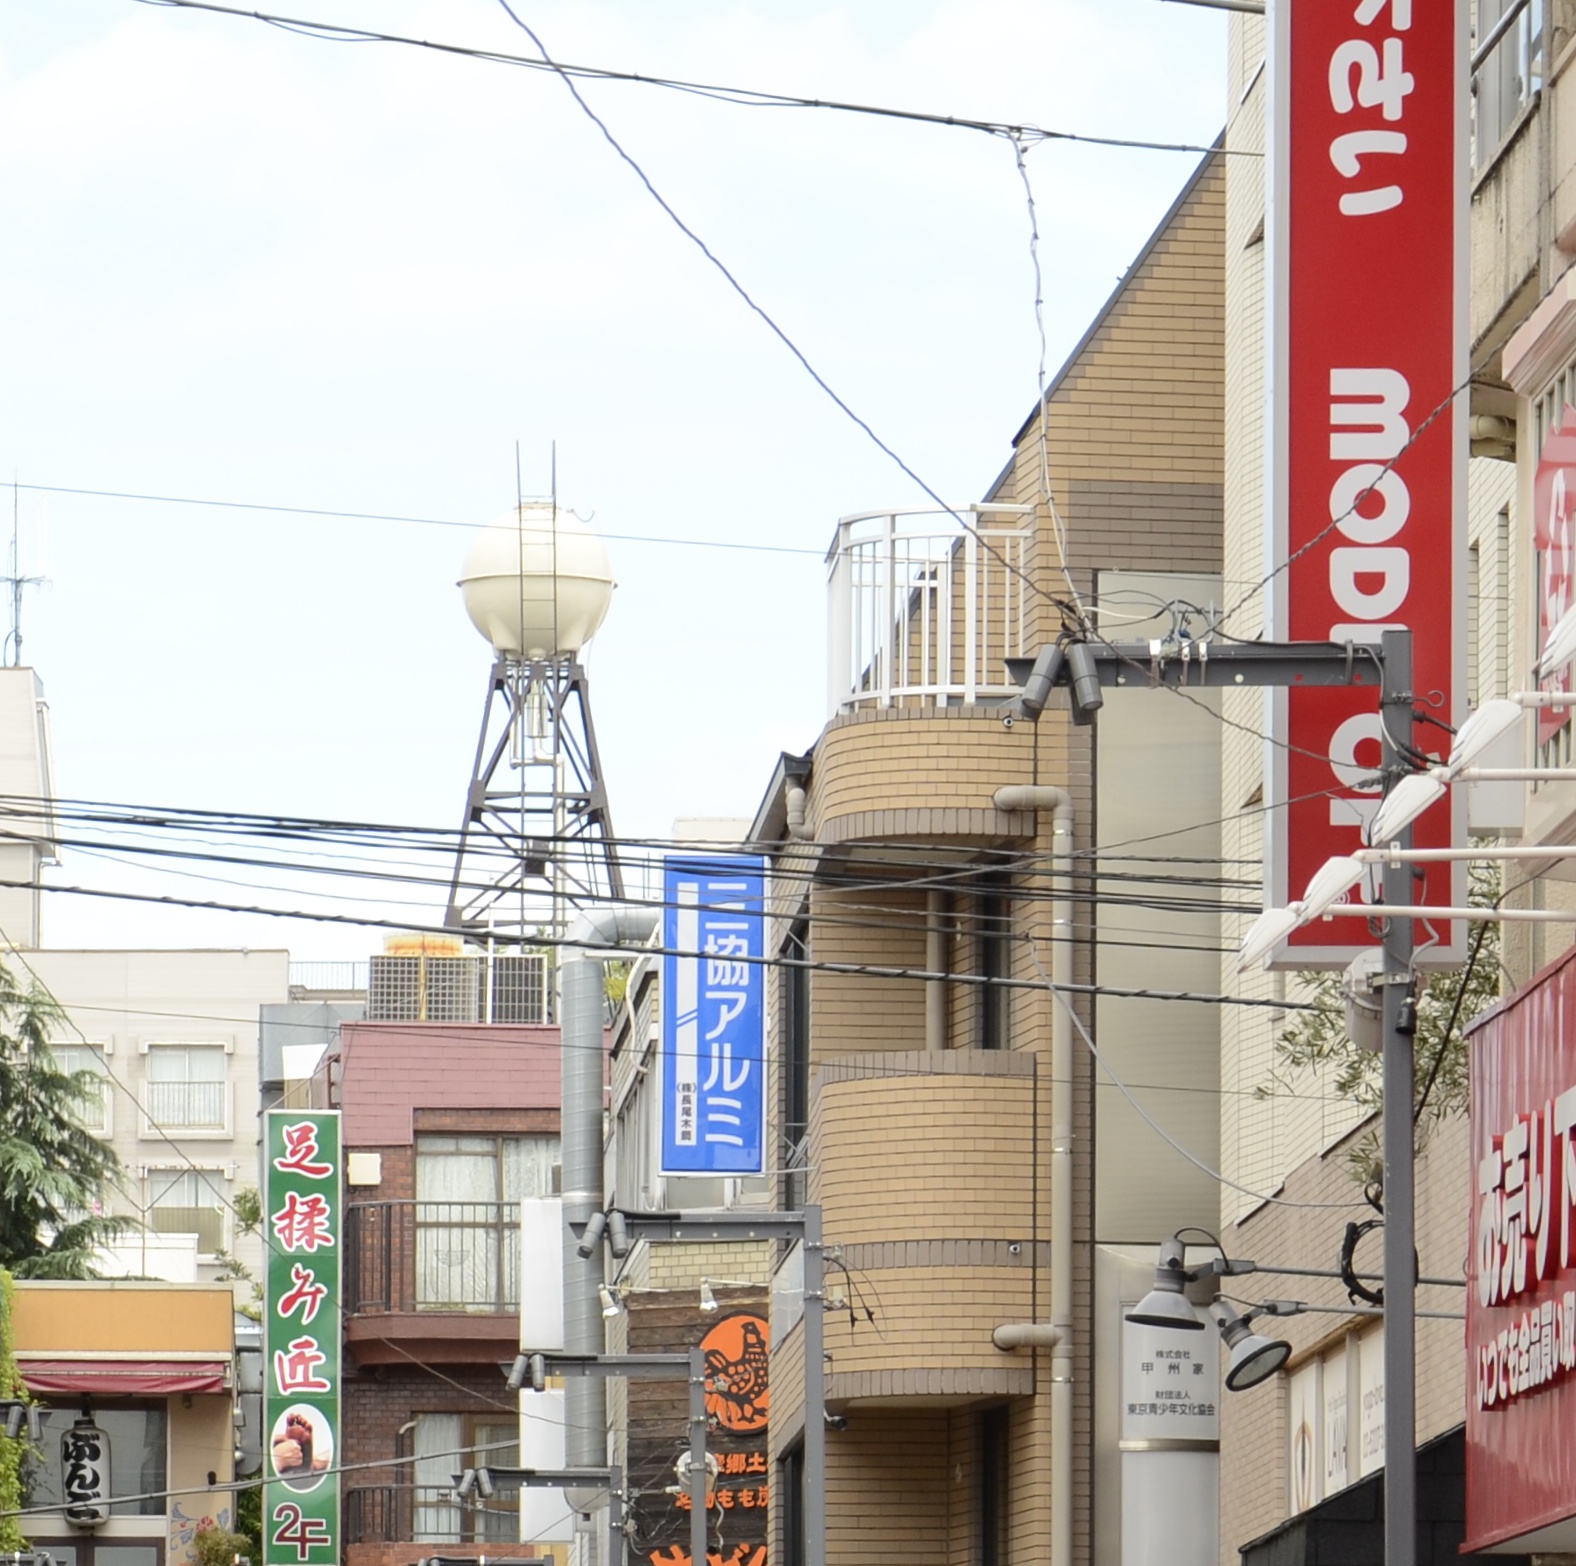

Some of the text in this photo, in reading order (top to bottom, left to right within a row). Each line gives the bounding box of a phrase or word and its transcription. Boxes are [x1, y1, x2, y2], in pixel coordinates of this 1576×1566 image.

[1330, 367, 1411, 644] MOD
[273, 1120, 335, 1397] 足揉み匠
[64, 1432, 101, 1520] ぶんご
